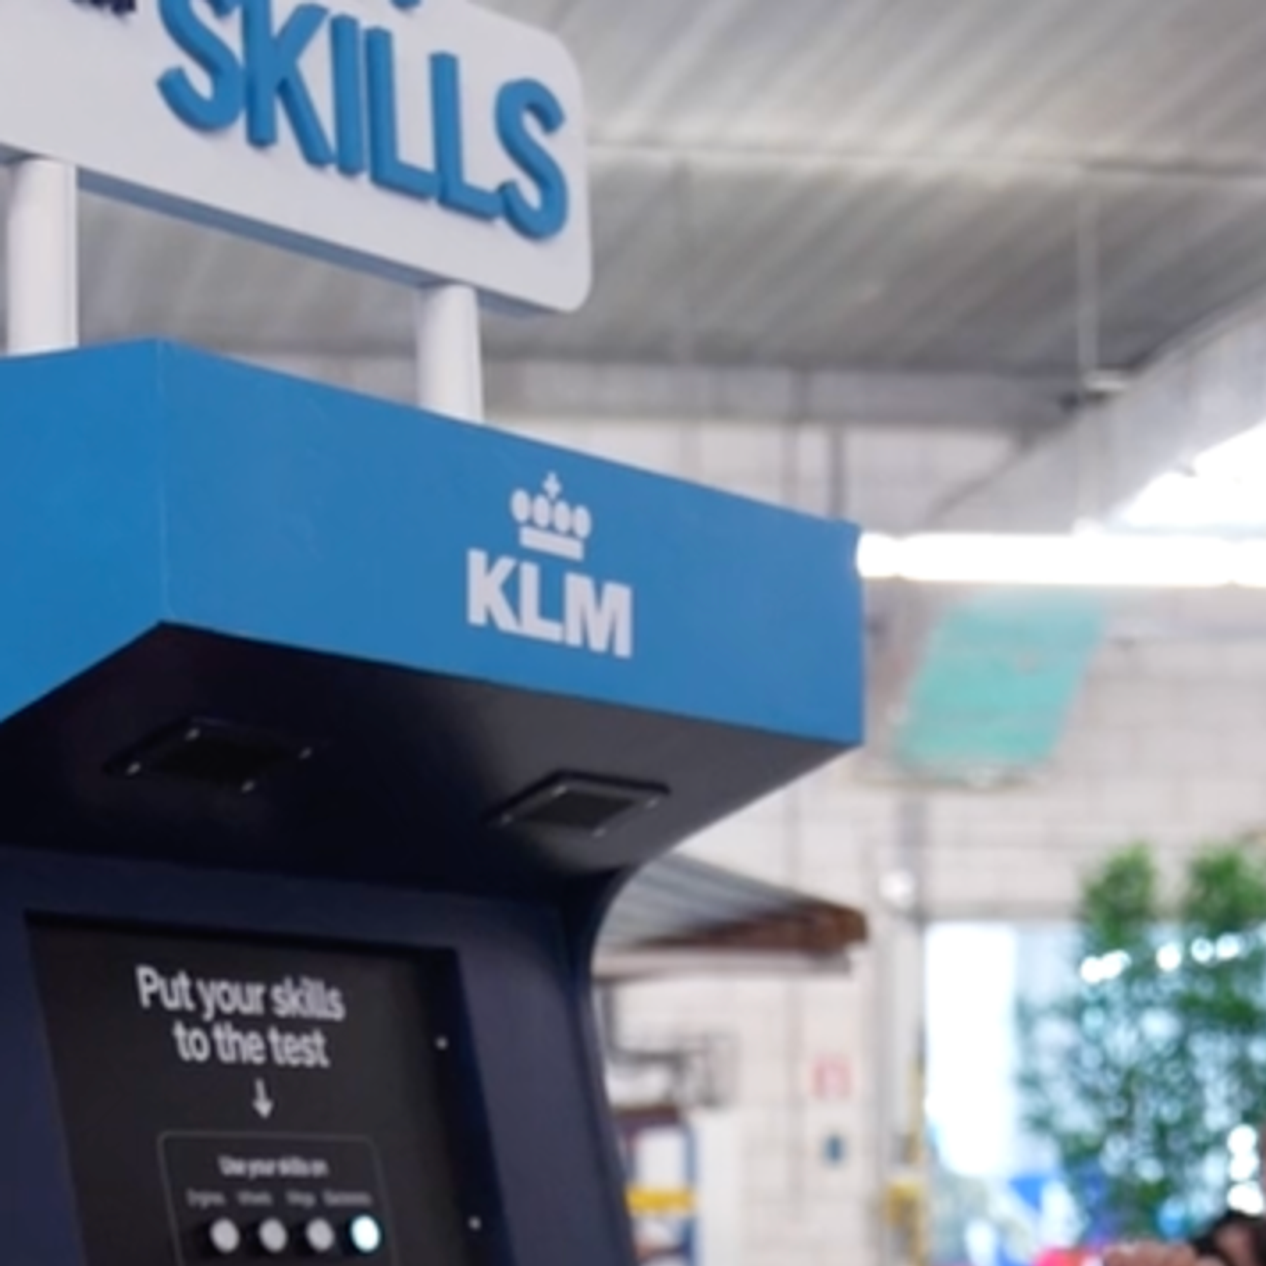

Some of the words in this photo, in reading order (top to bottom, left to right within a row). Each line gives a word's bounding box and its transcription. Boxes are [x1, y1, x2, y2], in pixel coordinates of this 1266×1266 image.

[156, 0, 570, 241] SKILLS
[466, 547, 633, 659] KLM
[136, 964, 195, 1012] Put
[197, 979, 266, 1021] your
[271, 976, 346, 1021] skills
[173, 1019, 211, 1062] to
[212, 1021, 265, 1065] the
[268, 1025, 330, 1069] test
